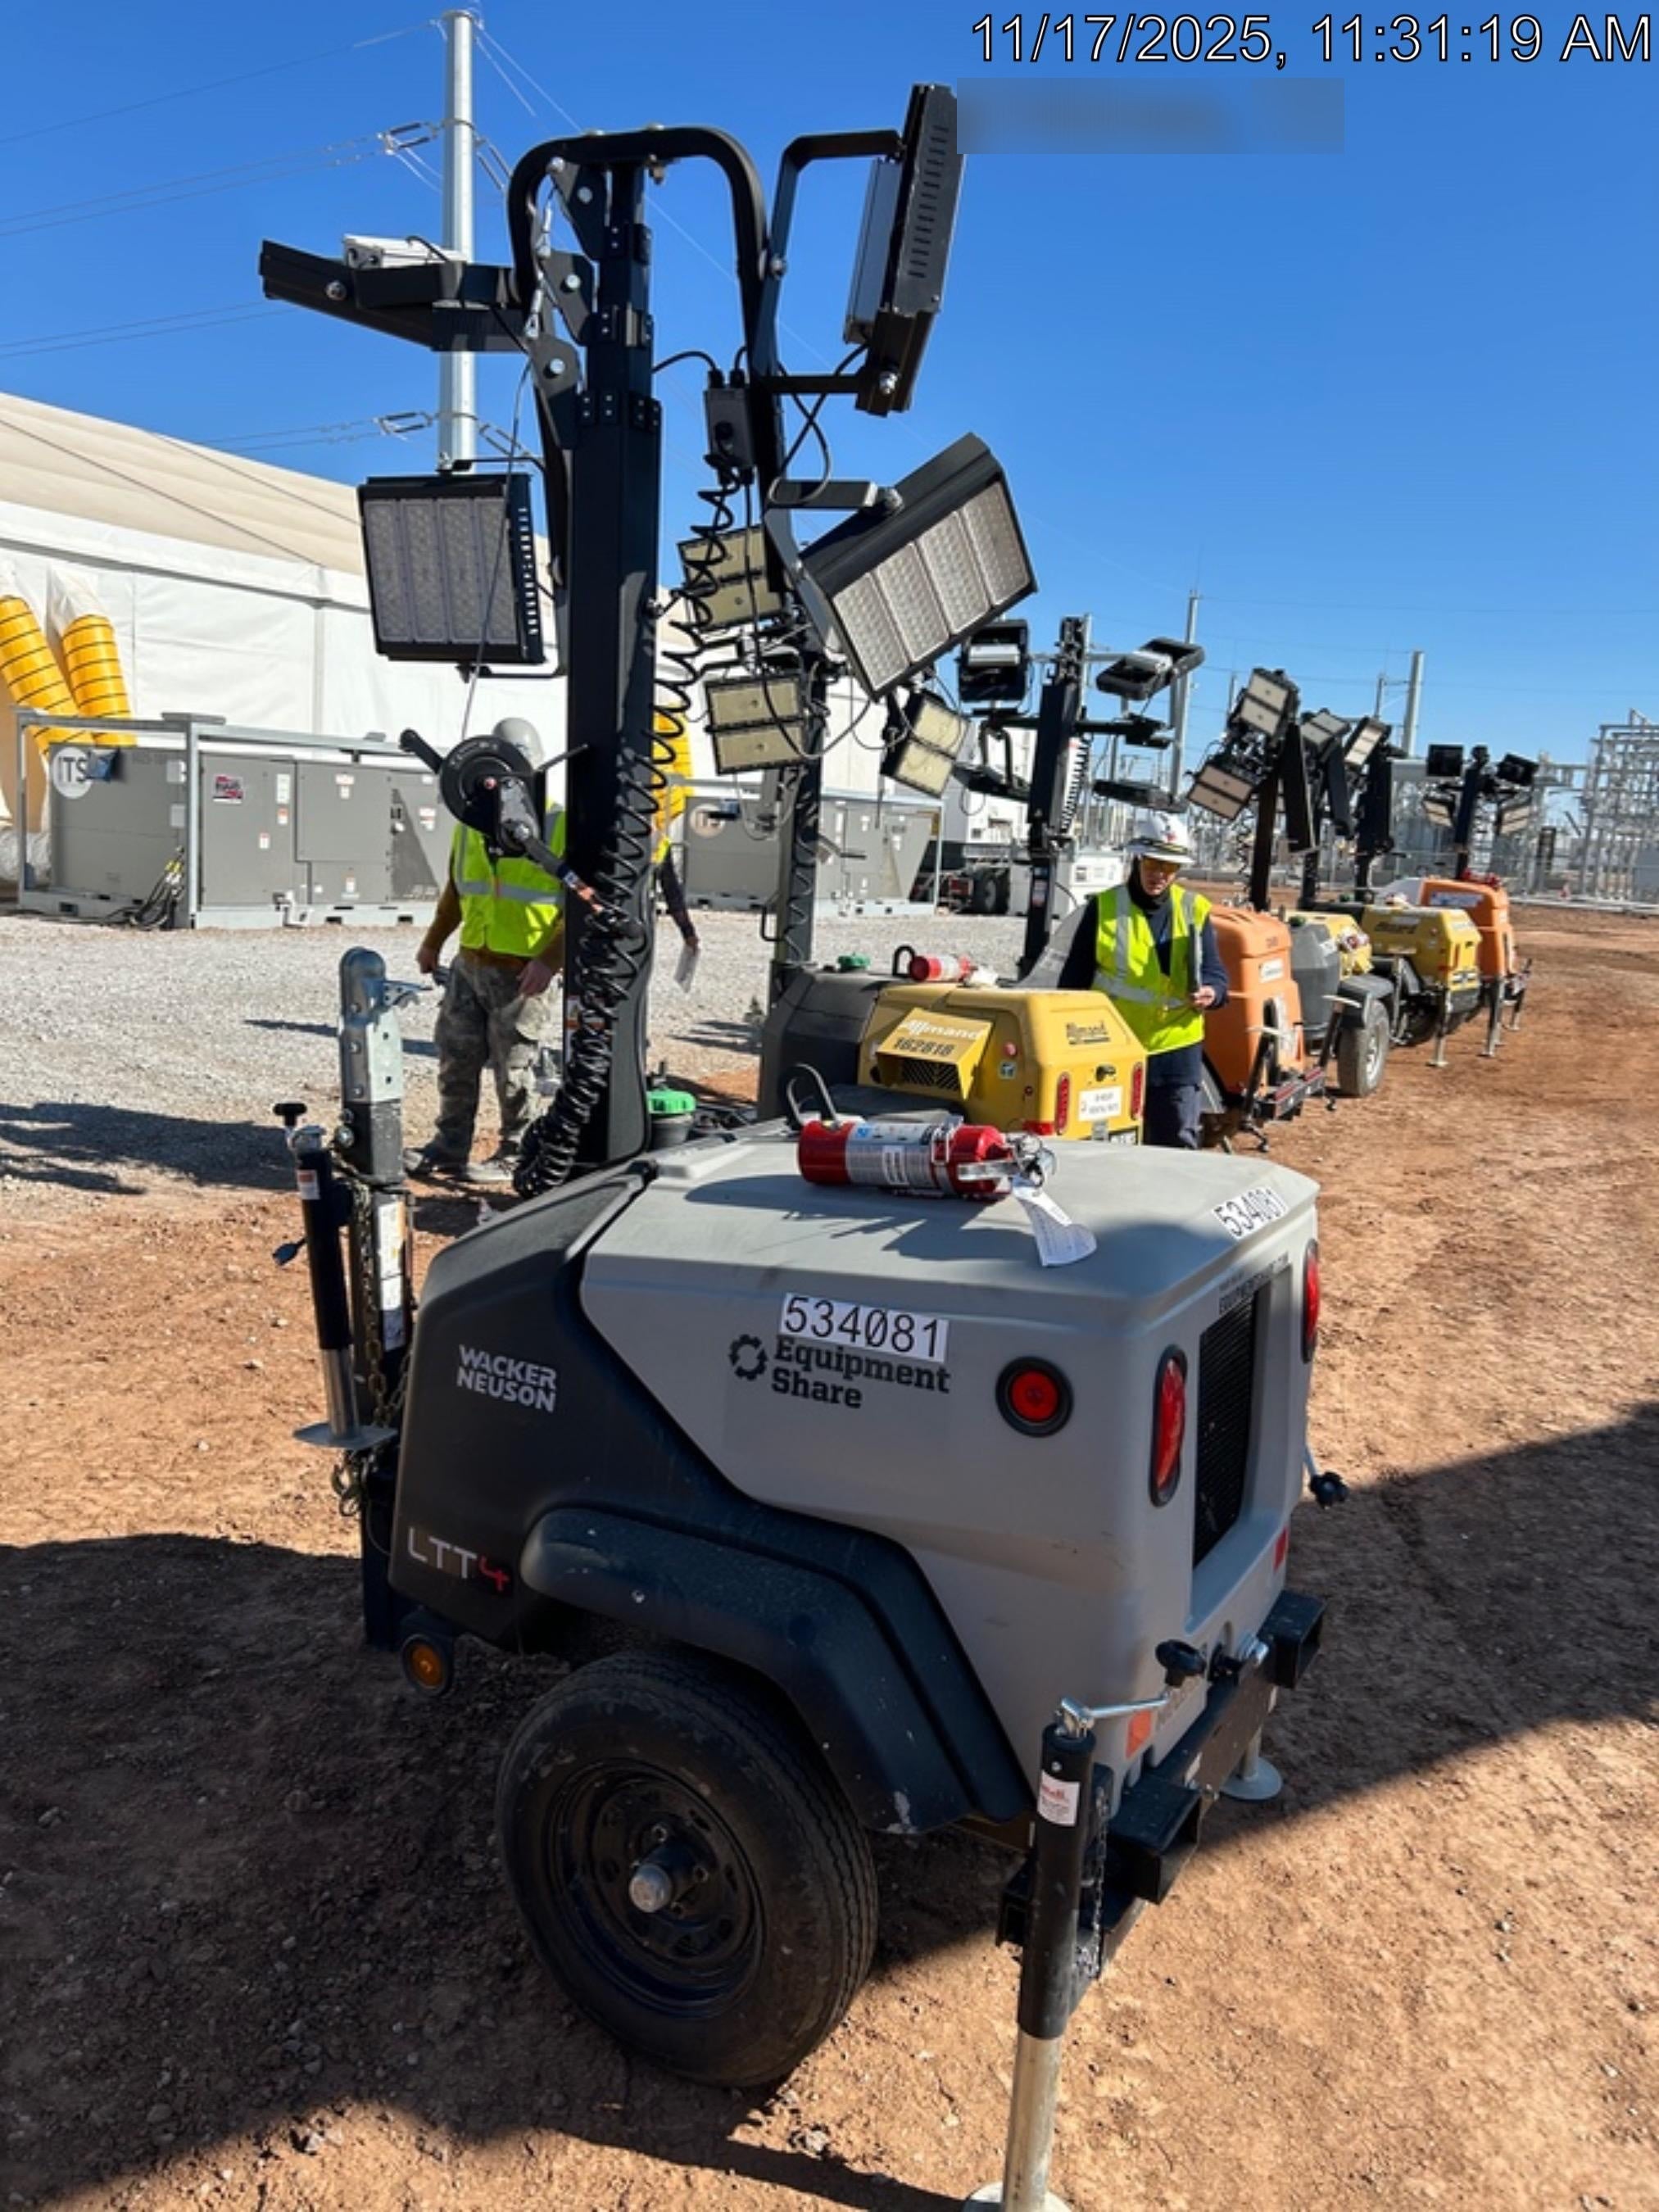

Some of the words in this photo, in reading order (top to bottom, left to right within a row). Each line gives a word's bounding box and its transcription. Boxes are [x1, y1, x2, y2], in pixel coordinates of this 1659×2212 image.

[784, 1296, 938, 1358] 534081
[456, 1367, 557, 1412] NEUSON
[459, 1344, 557, 1390] WACKER
[771, 1367, 863, 1409] Share
[774, 1335, 951, 1394] Equipment
[407, 1527, 509, 1592] LTT4
